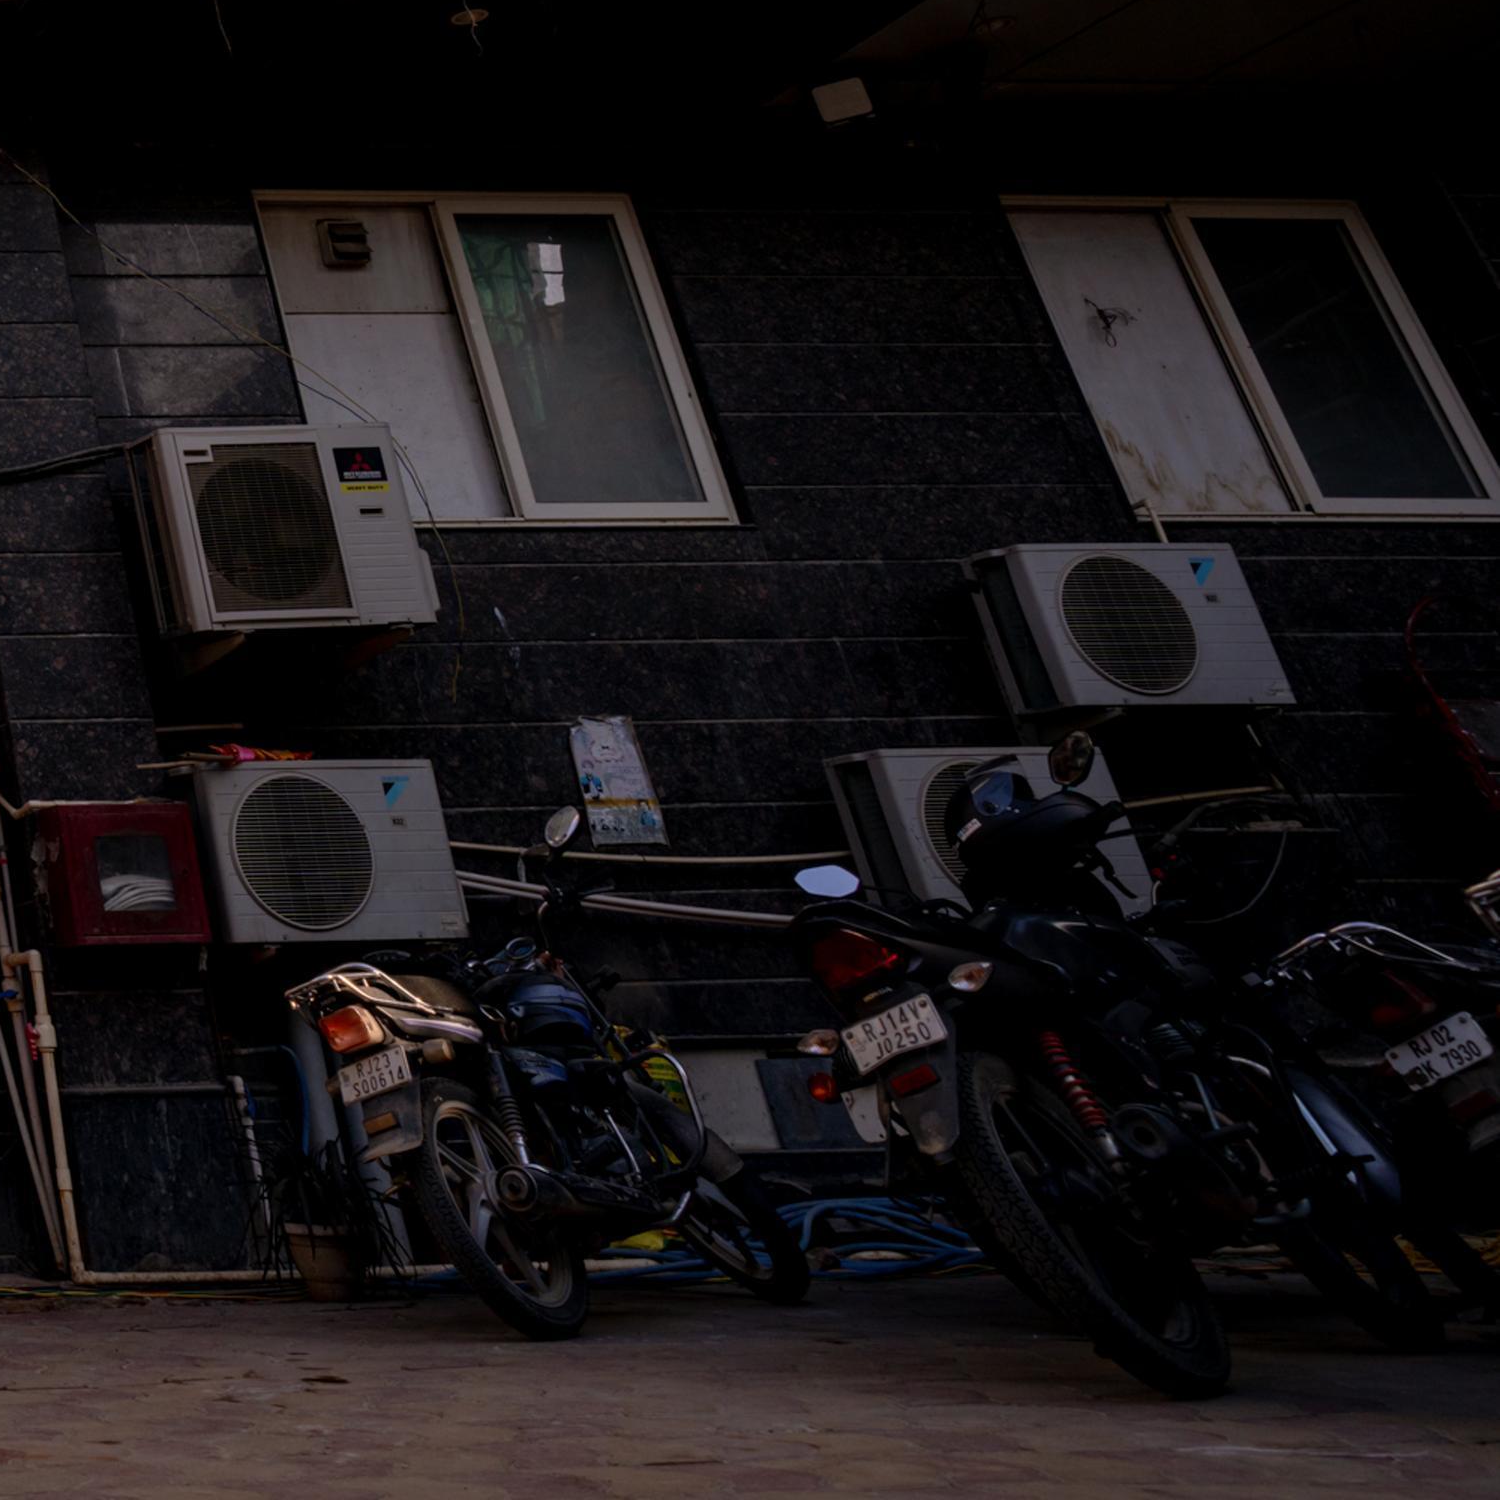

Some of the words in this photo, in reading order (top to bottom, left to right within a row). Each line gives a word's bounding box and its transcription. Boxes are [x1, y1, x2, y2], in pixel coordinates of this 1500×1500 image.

[875, 1021, 933, 1061] J0250
[1408, 1034, 1433, 1059] RJ
[1430, 1024, 1456, 1047] 02
[1439, 1039, 1483, 1071] 7930
[355, 1053, 392, 1079] RJ23
